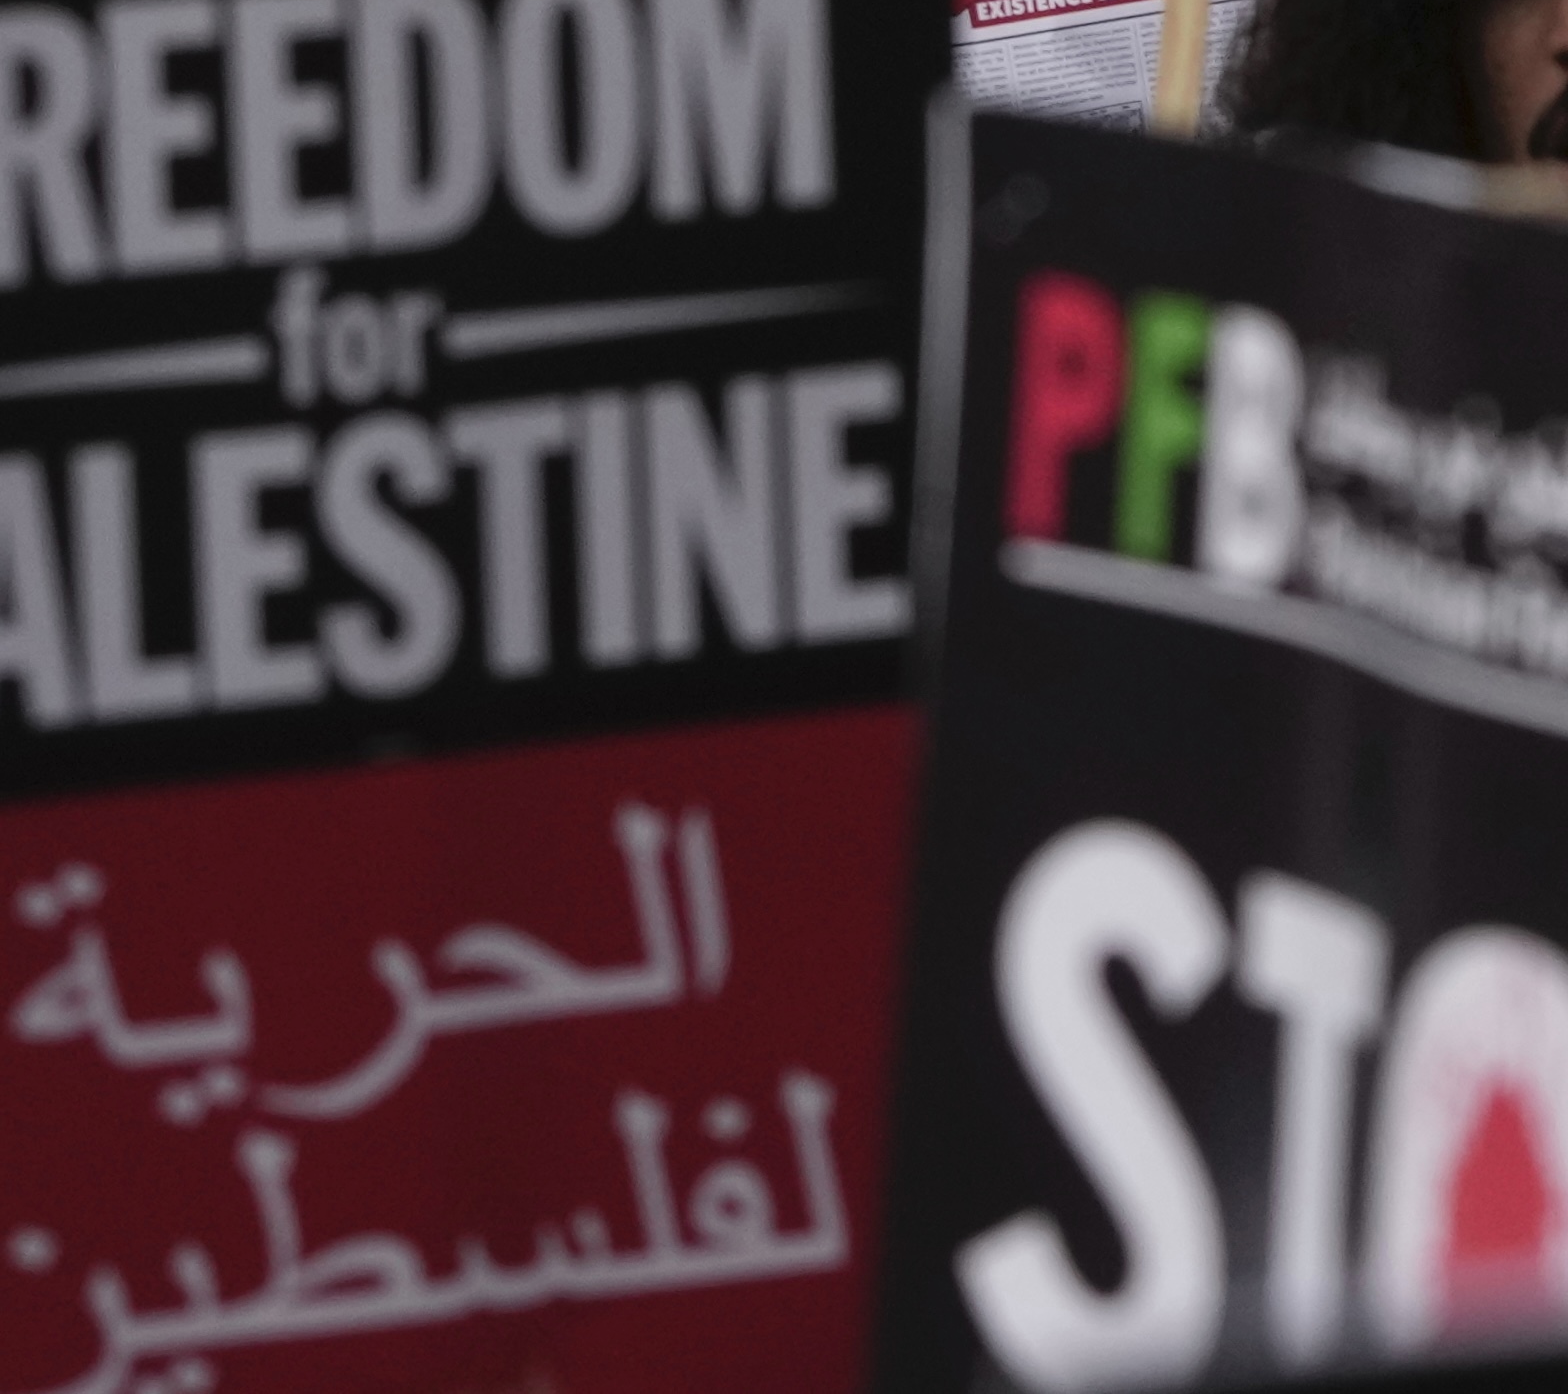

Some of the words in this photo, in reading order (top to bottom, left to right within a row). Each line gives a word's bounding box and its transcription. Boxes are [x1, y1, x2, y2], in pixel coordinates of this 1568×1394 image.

[270, 266, 442, 410] for
[1007, 268, 1304, 593] PFB
[15, 798, 732, 1126] الحرية
